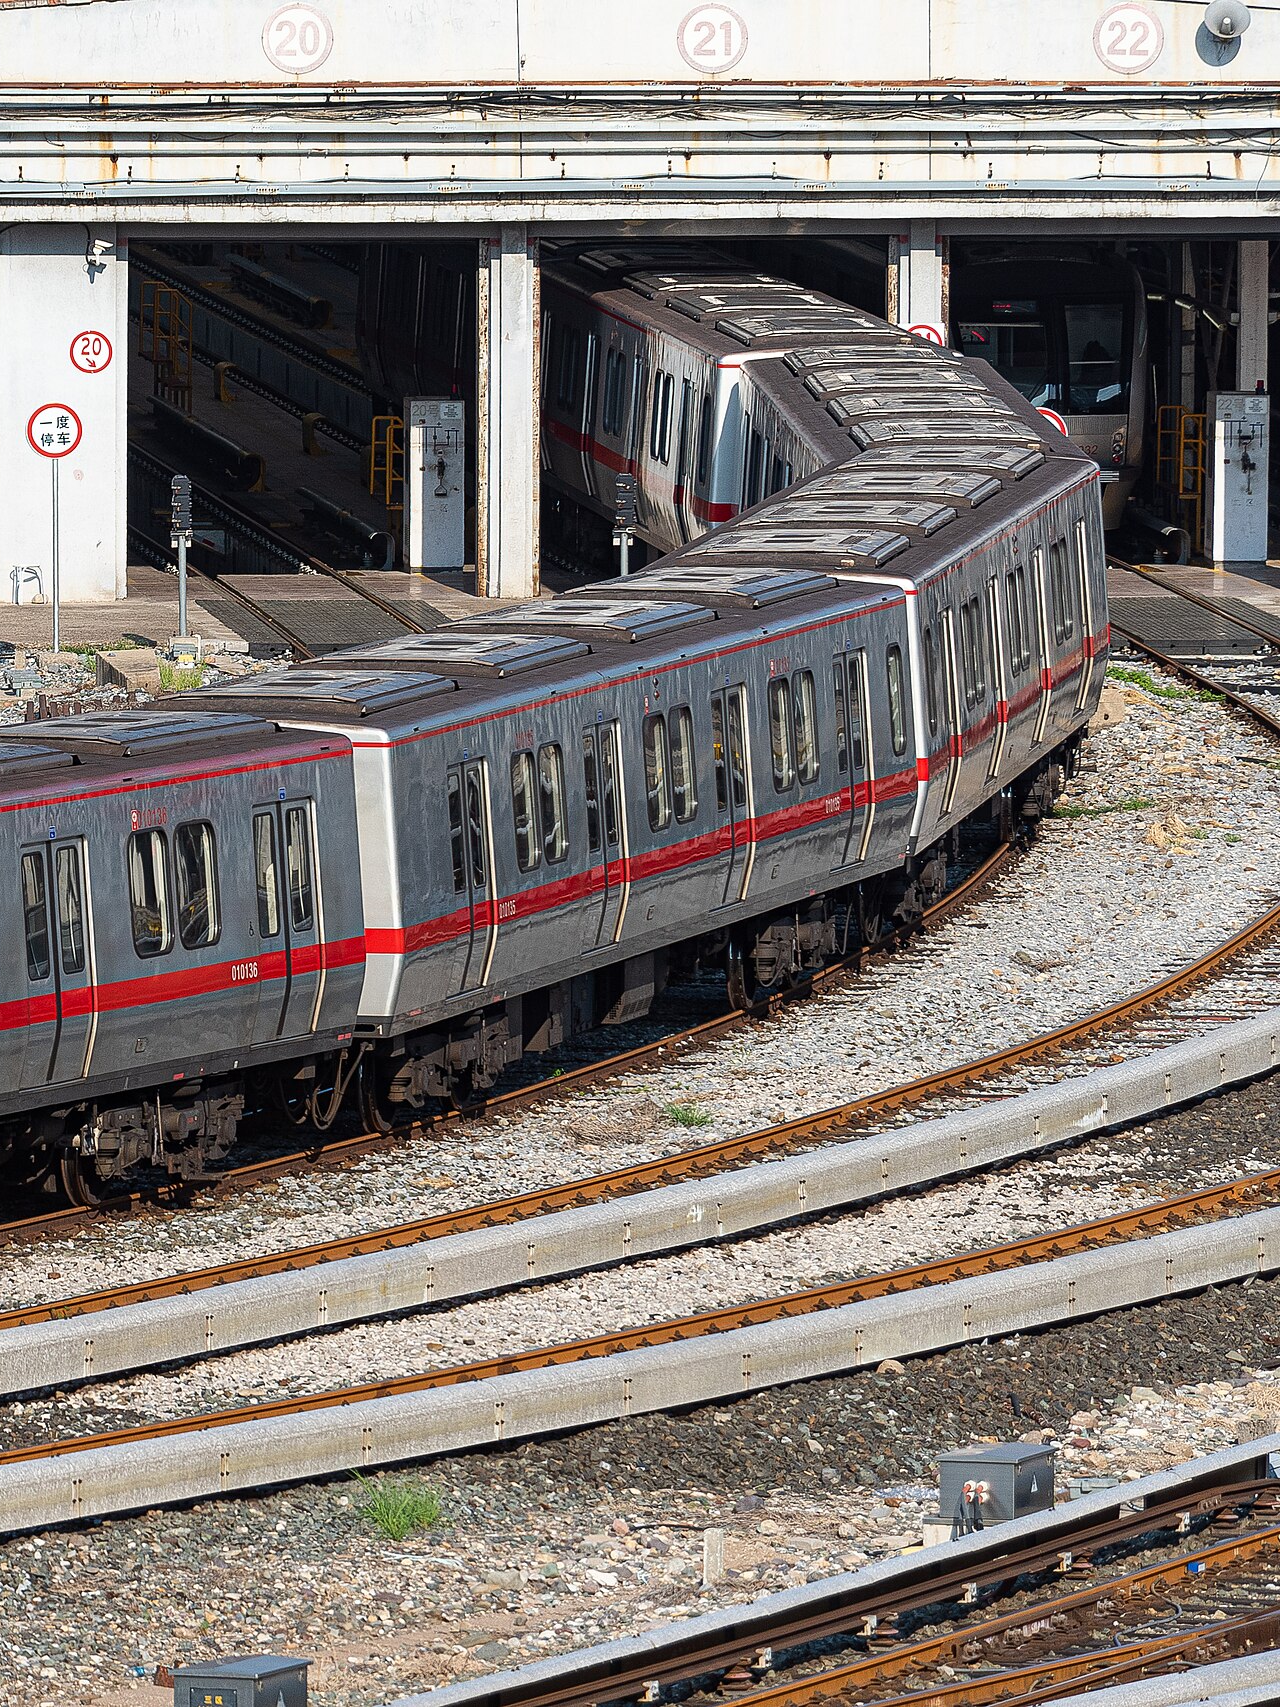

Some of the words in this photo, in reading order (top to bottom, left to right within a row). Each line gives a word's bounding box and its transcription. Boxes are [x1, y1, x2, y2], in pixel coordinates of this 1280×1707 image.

[275, 21, 321, 56] 20
[694, 21, 732, 55] 21
[1107, 21, 1149, 56] 22
[81, 337, 103, 356] 20
[39, 415, 70, 430] 一度
[40, 432, 71, 447] 停车
[231, 961, 258, 981] 010136
[376, 1024, 383, 1035] 1
